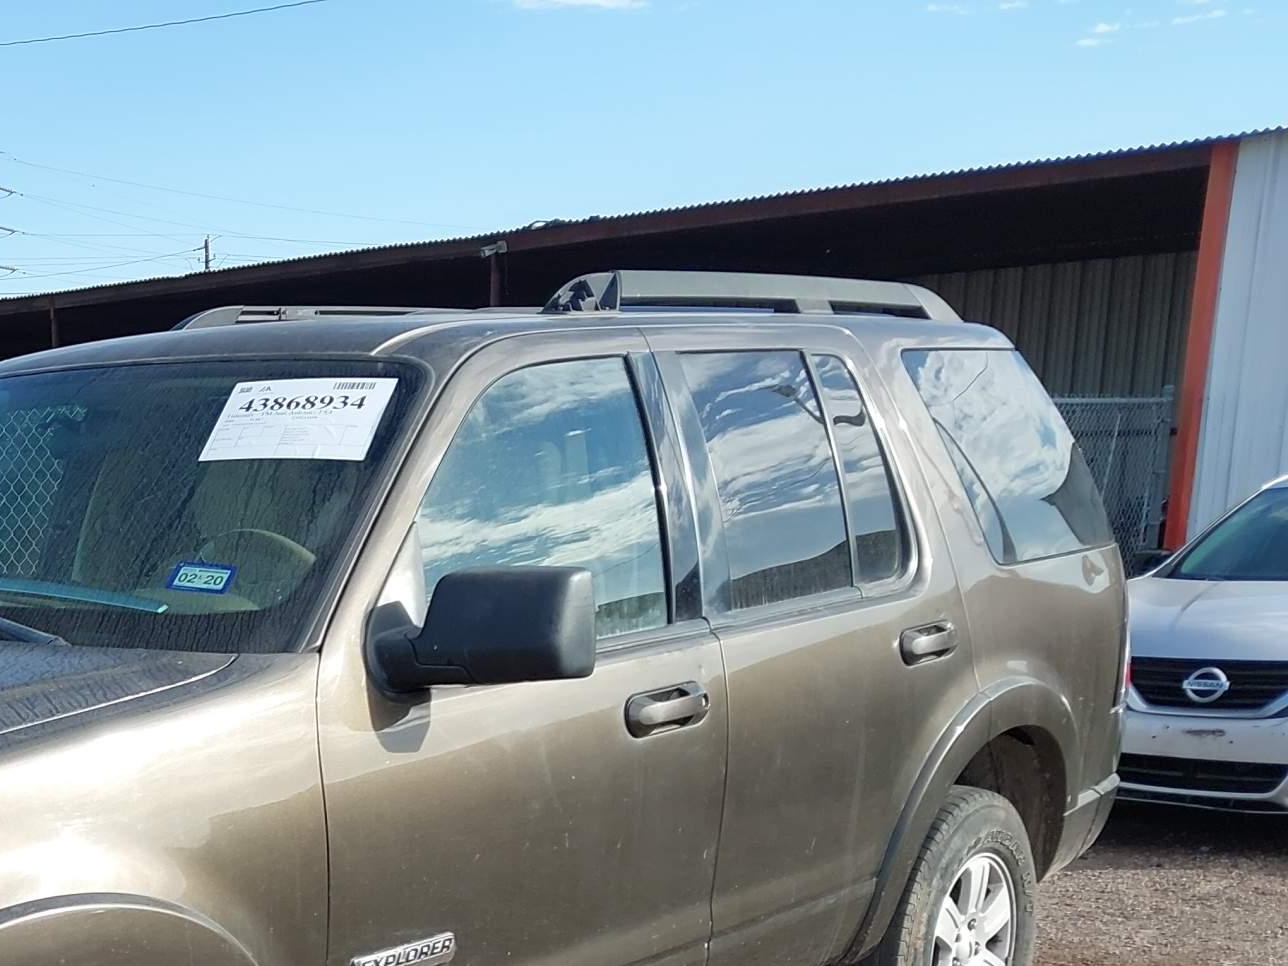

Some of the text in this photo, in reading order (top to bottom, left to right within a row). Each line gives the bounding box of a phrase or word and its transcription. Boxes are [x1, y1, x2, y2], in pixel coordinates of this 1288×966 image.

[240, 394, 368, 412] 43868934
[177, 572, 224, 586] 02 20
